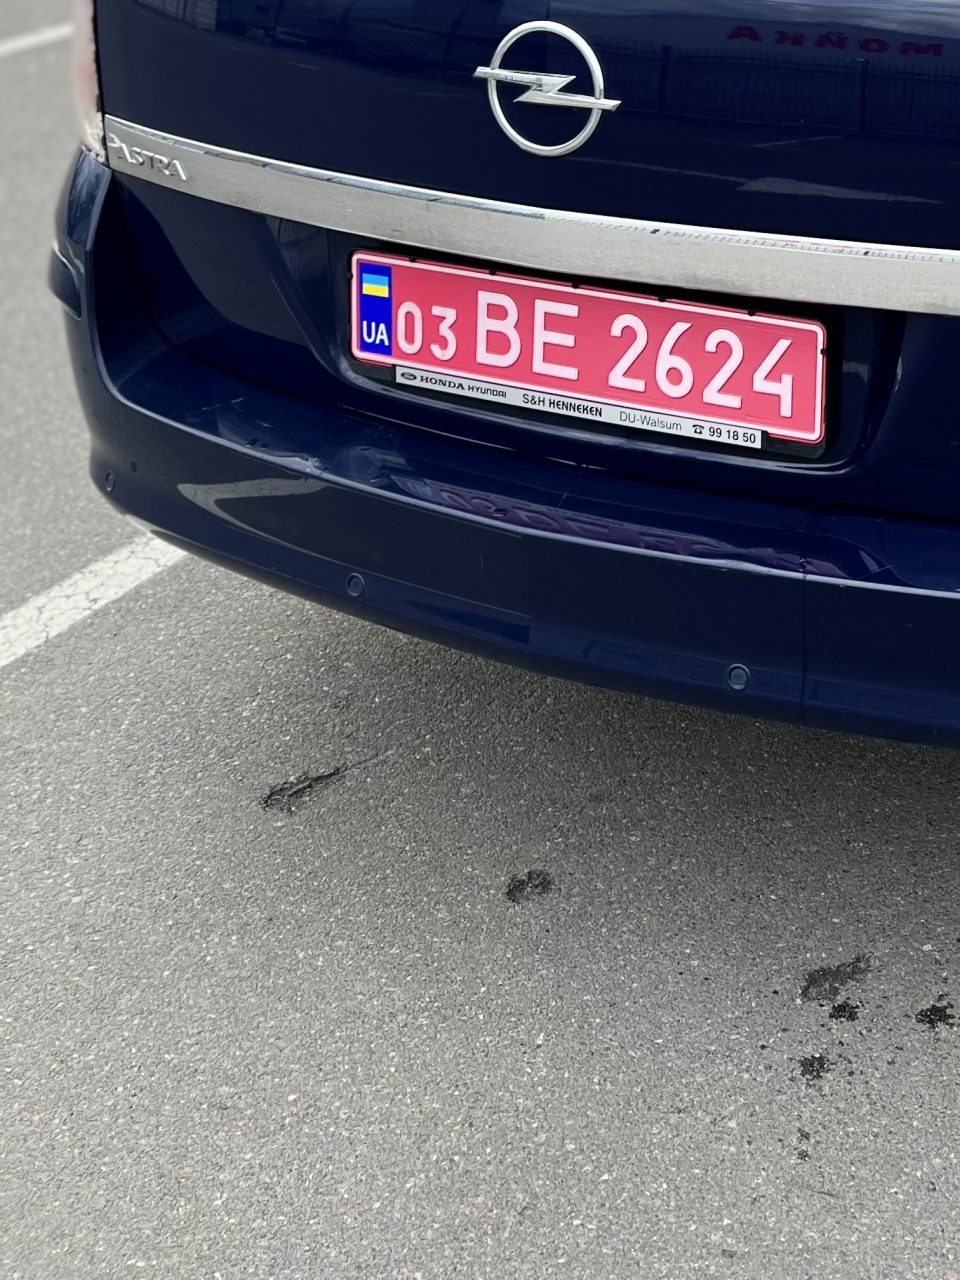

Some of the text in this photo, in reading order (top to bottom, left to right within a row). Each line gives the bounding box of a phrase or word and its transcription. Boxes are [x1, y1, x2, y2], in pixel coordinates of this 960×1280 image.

[108, 132, 187, 180] ASTRA
[363, 320, 389, 346] UA
[397, 290, 794, 418] 03 BE 2624
[419, 375, 465, 391] HONDA
[522, 393, 546, 408] S&H
[548, 399, 603, 418] HENNEKEN
[619, 411, 682, 432] DU-Walsum
[708, 426, 722, 439] 99
[726, 429, 739, 441] 18
[742, 432, 756, 445] 50
